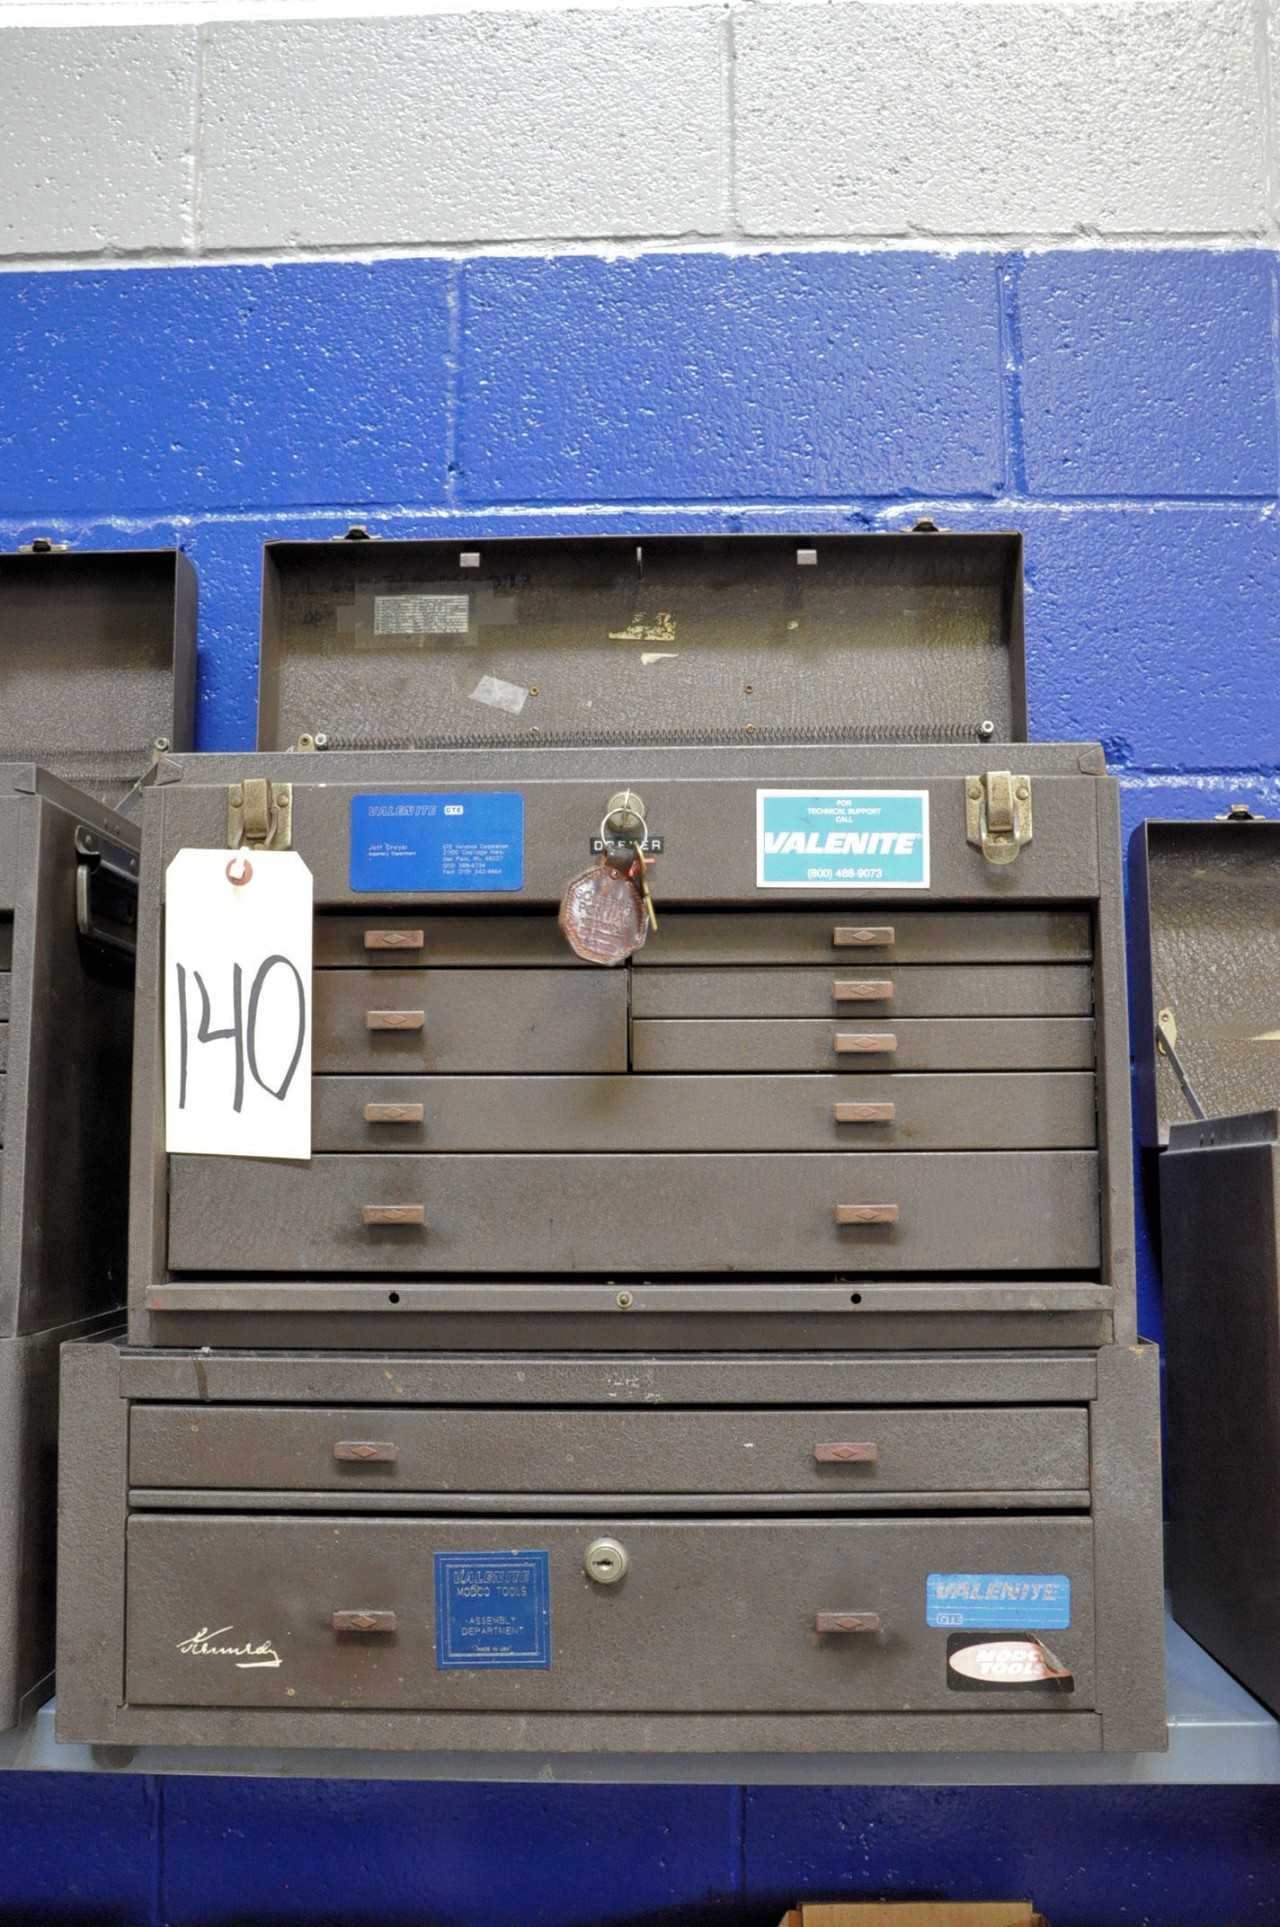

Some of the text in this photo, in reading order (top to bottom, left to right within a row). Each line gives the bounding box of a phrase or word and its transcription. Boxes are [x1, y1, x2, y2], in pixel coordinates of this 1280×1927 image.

[836, 799, 852, 807] FOR
[808, 807, 846, 815] TECHNICAL
[765, 832, 917, 855] VALENITE
[808, 868, 833, 880] (800)
[176, 954, 305, 1113] 140
[935, 1581, 1058, 1600] VALENITE
[461, 1626, 524, 1636] DEPARTMENT
[176, 1626, 283, 1667] Kennedy
